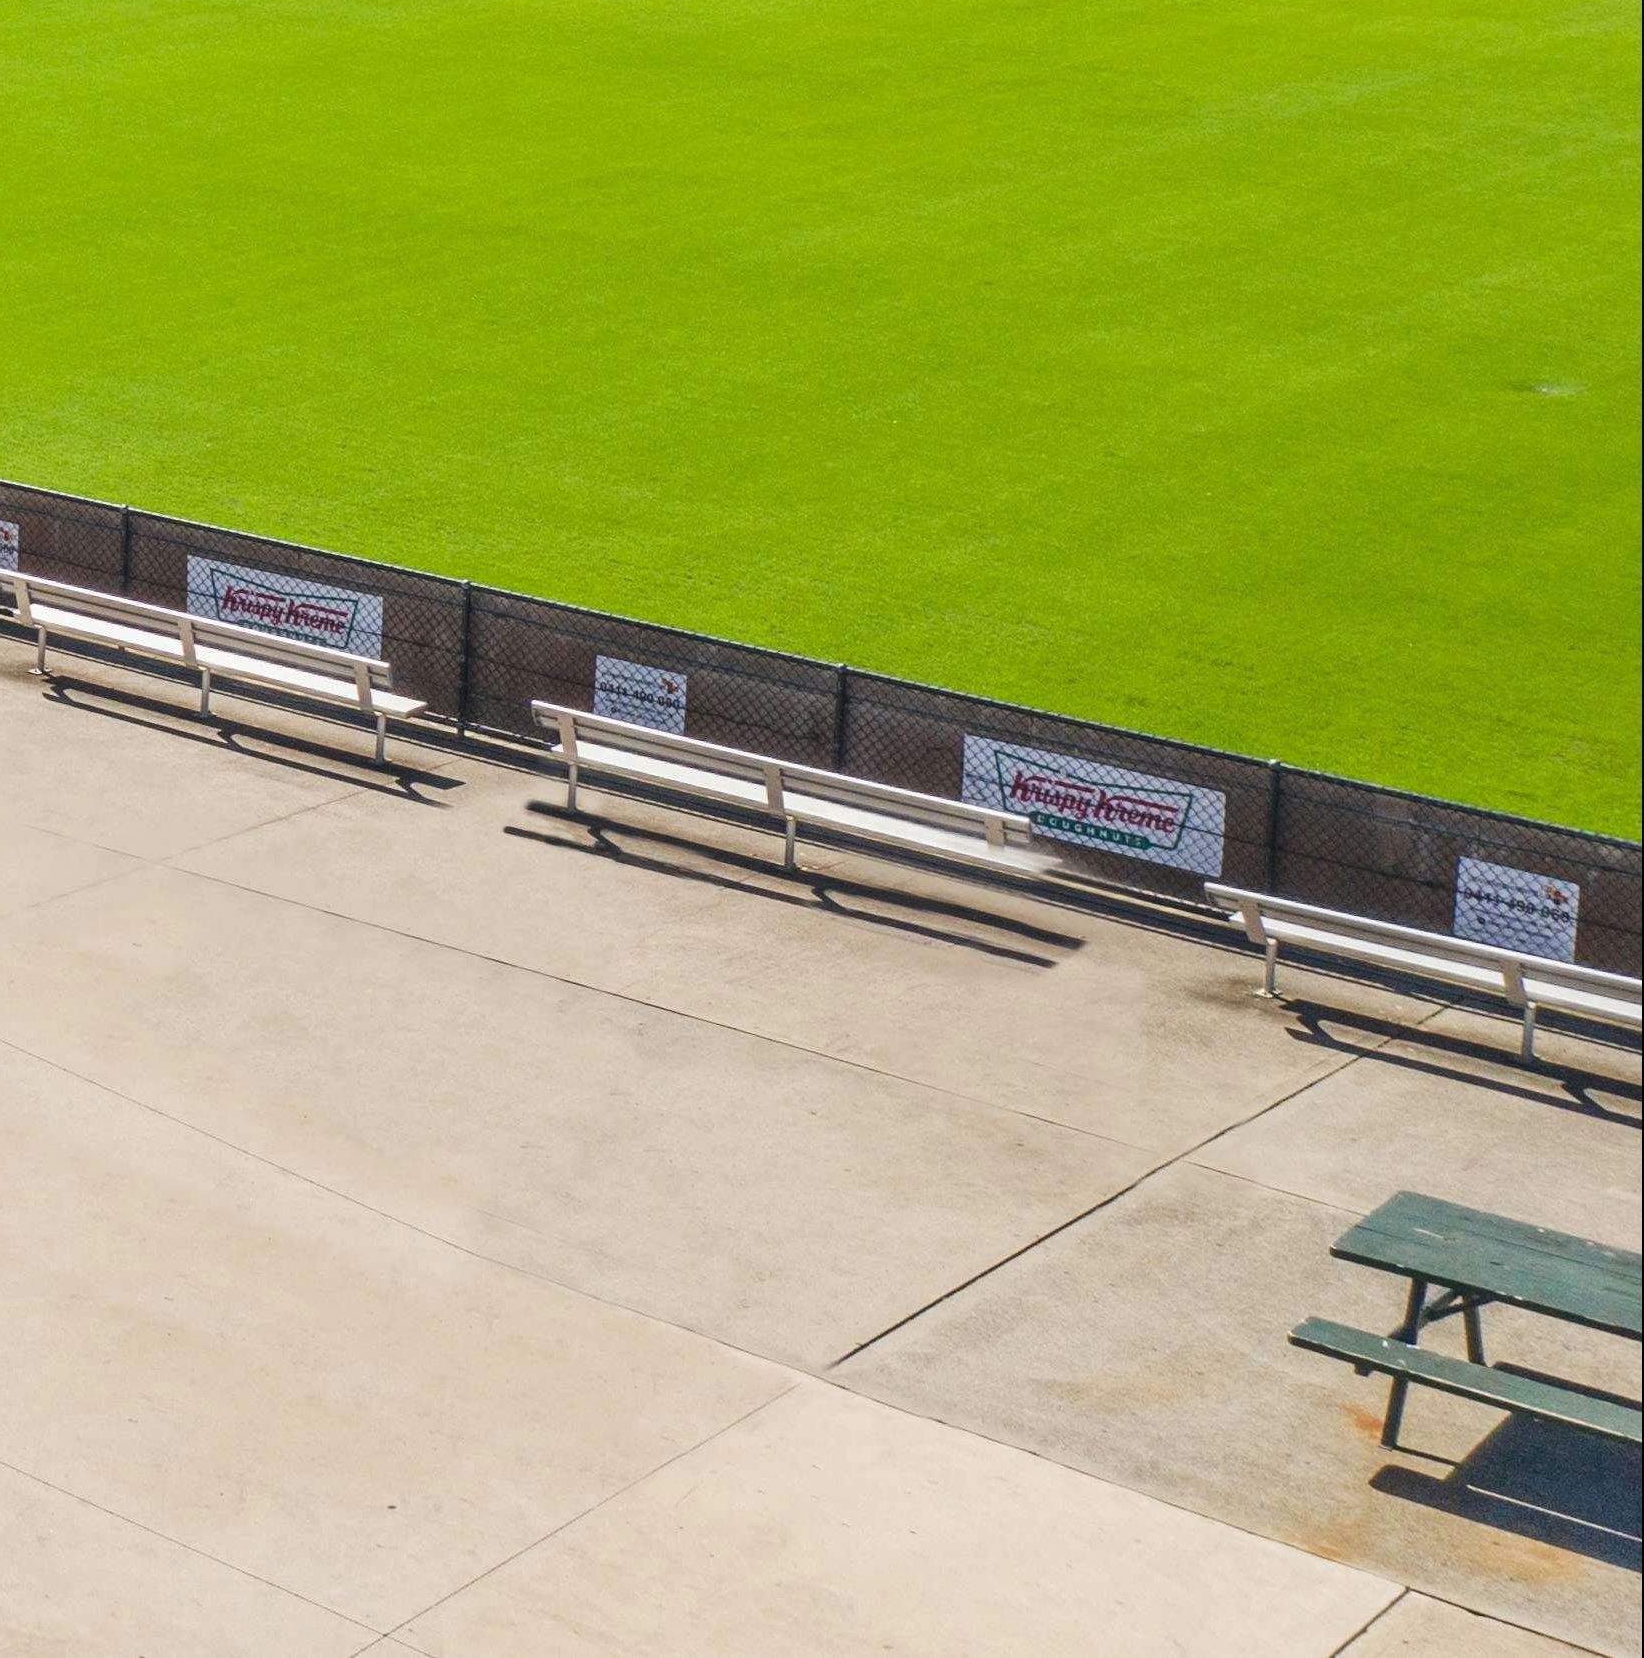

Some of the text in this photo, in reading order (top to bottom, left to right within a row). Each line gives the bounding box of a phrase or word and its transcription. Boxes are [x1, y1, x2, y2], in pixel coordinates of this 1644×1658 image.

[223, 585, 287, 626] Krispy
[286, 598, 349, 634] Kreme
[1009, 771, 1179, 833] Krispy Kreme
[1036, 816, 1143, 847] DOUGHNUTS
